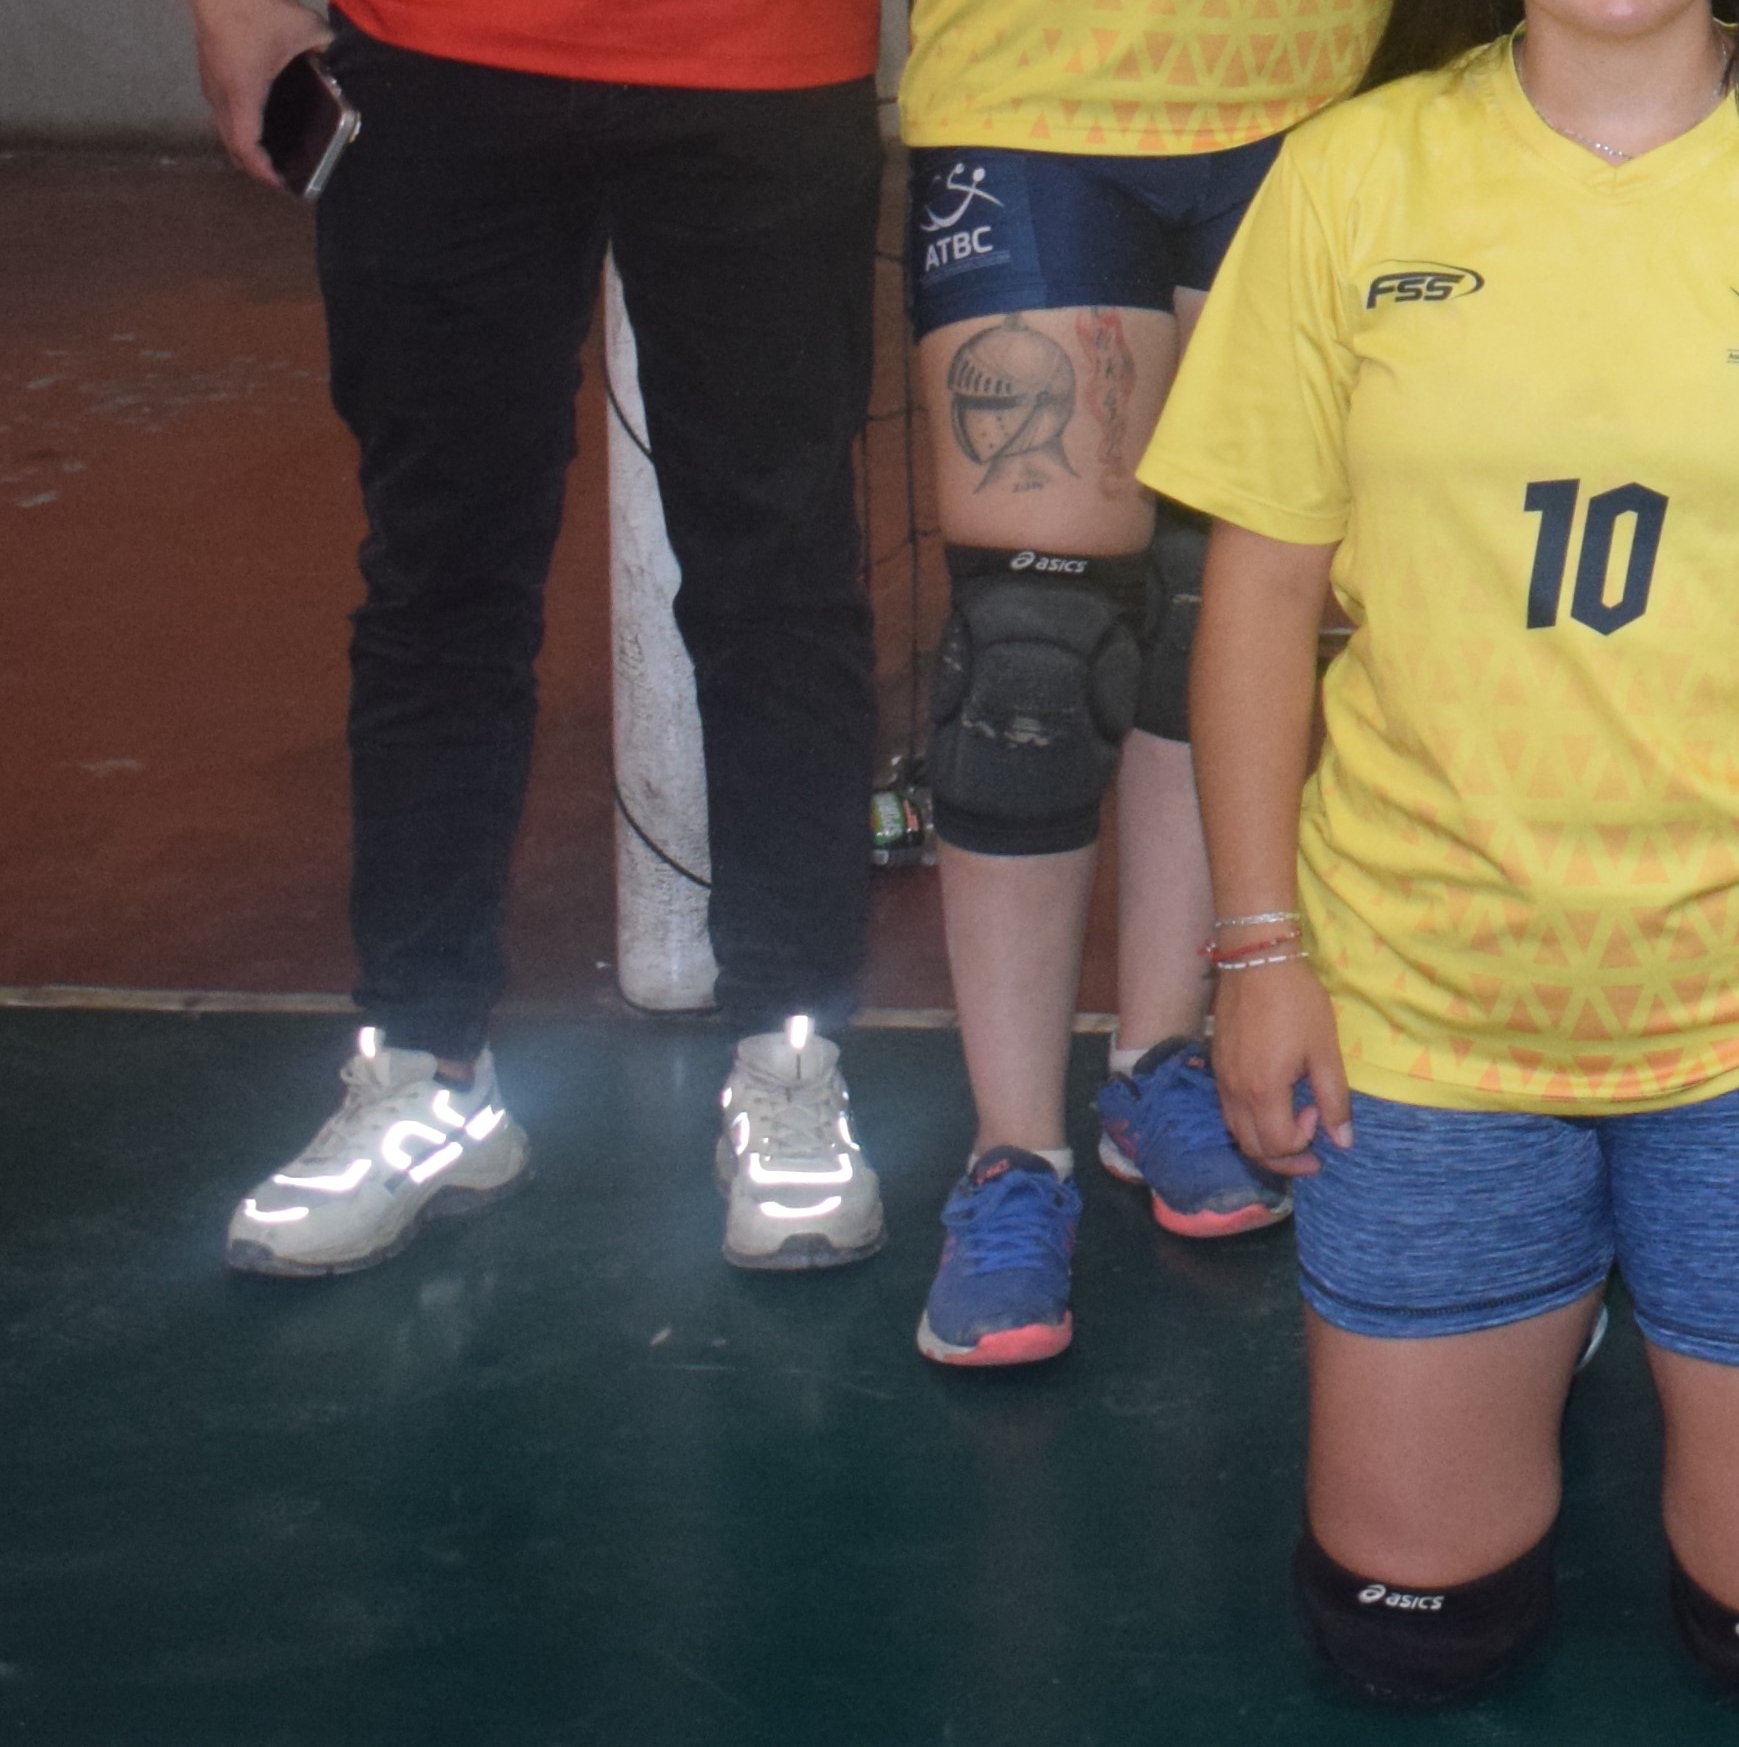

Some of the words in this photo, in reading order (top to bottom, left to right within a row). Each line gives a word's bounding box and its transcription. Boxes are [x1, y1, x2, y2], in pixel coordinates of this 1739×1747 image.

[926, 226, 993, 272] ATBC
[1366, 271, 1465, 309] FSS
[1035, 556, 1088, 574] asics
[1385, 1592, 1445, 1610] asics
